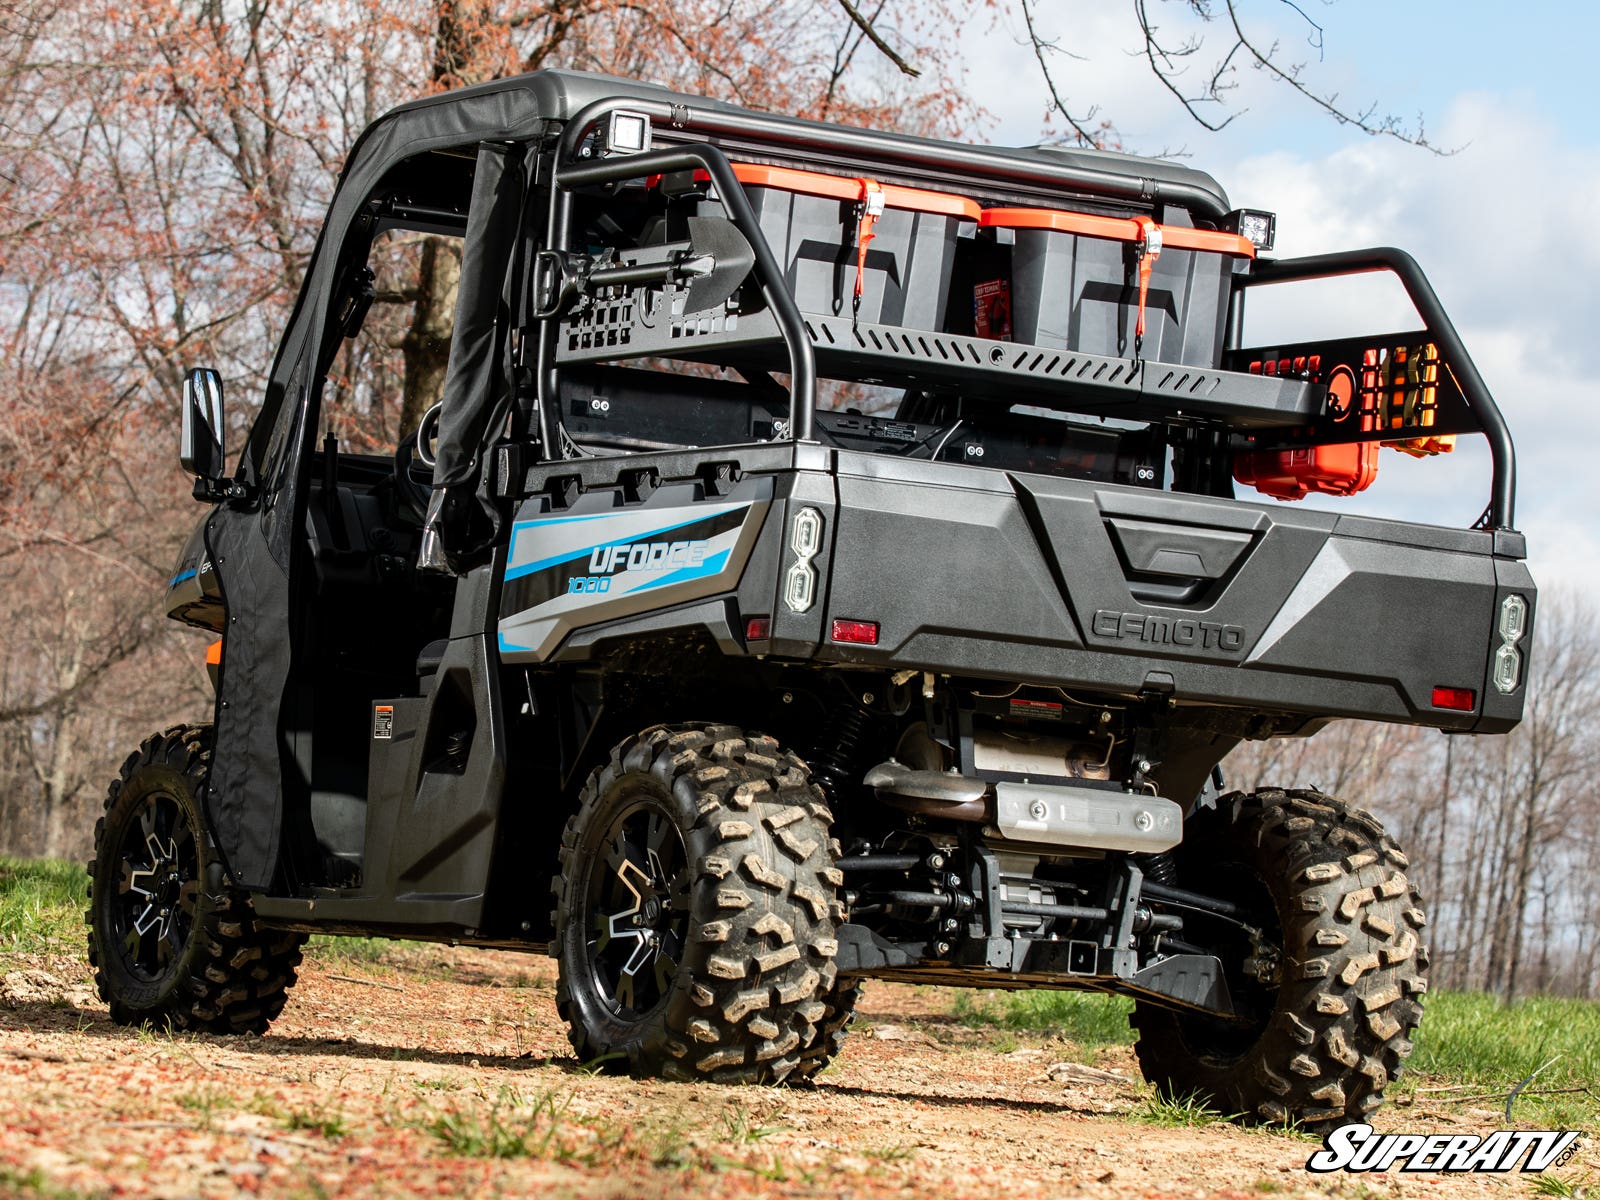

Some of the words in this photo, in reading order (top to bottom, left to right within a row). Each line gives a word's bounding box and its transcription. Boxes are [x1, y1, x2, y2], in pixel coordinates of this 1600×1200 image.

[588, 538, 709, 574] UFORCE
[567, 576, 611, 594] 1000
[1092, 609, 1247, 651] CFMOTO
